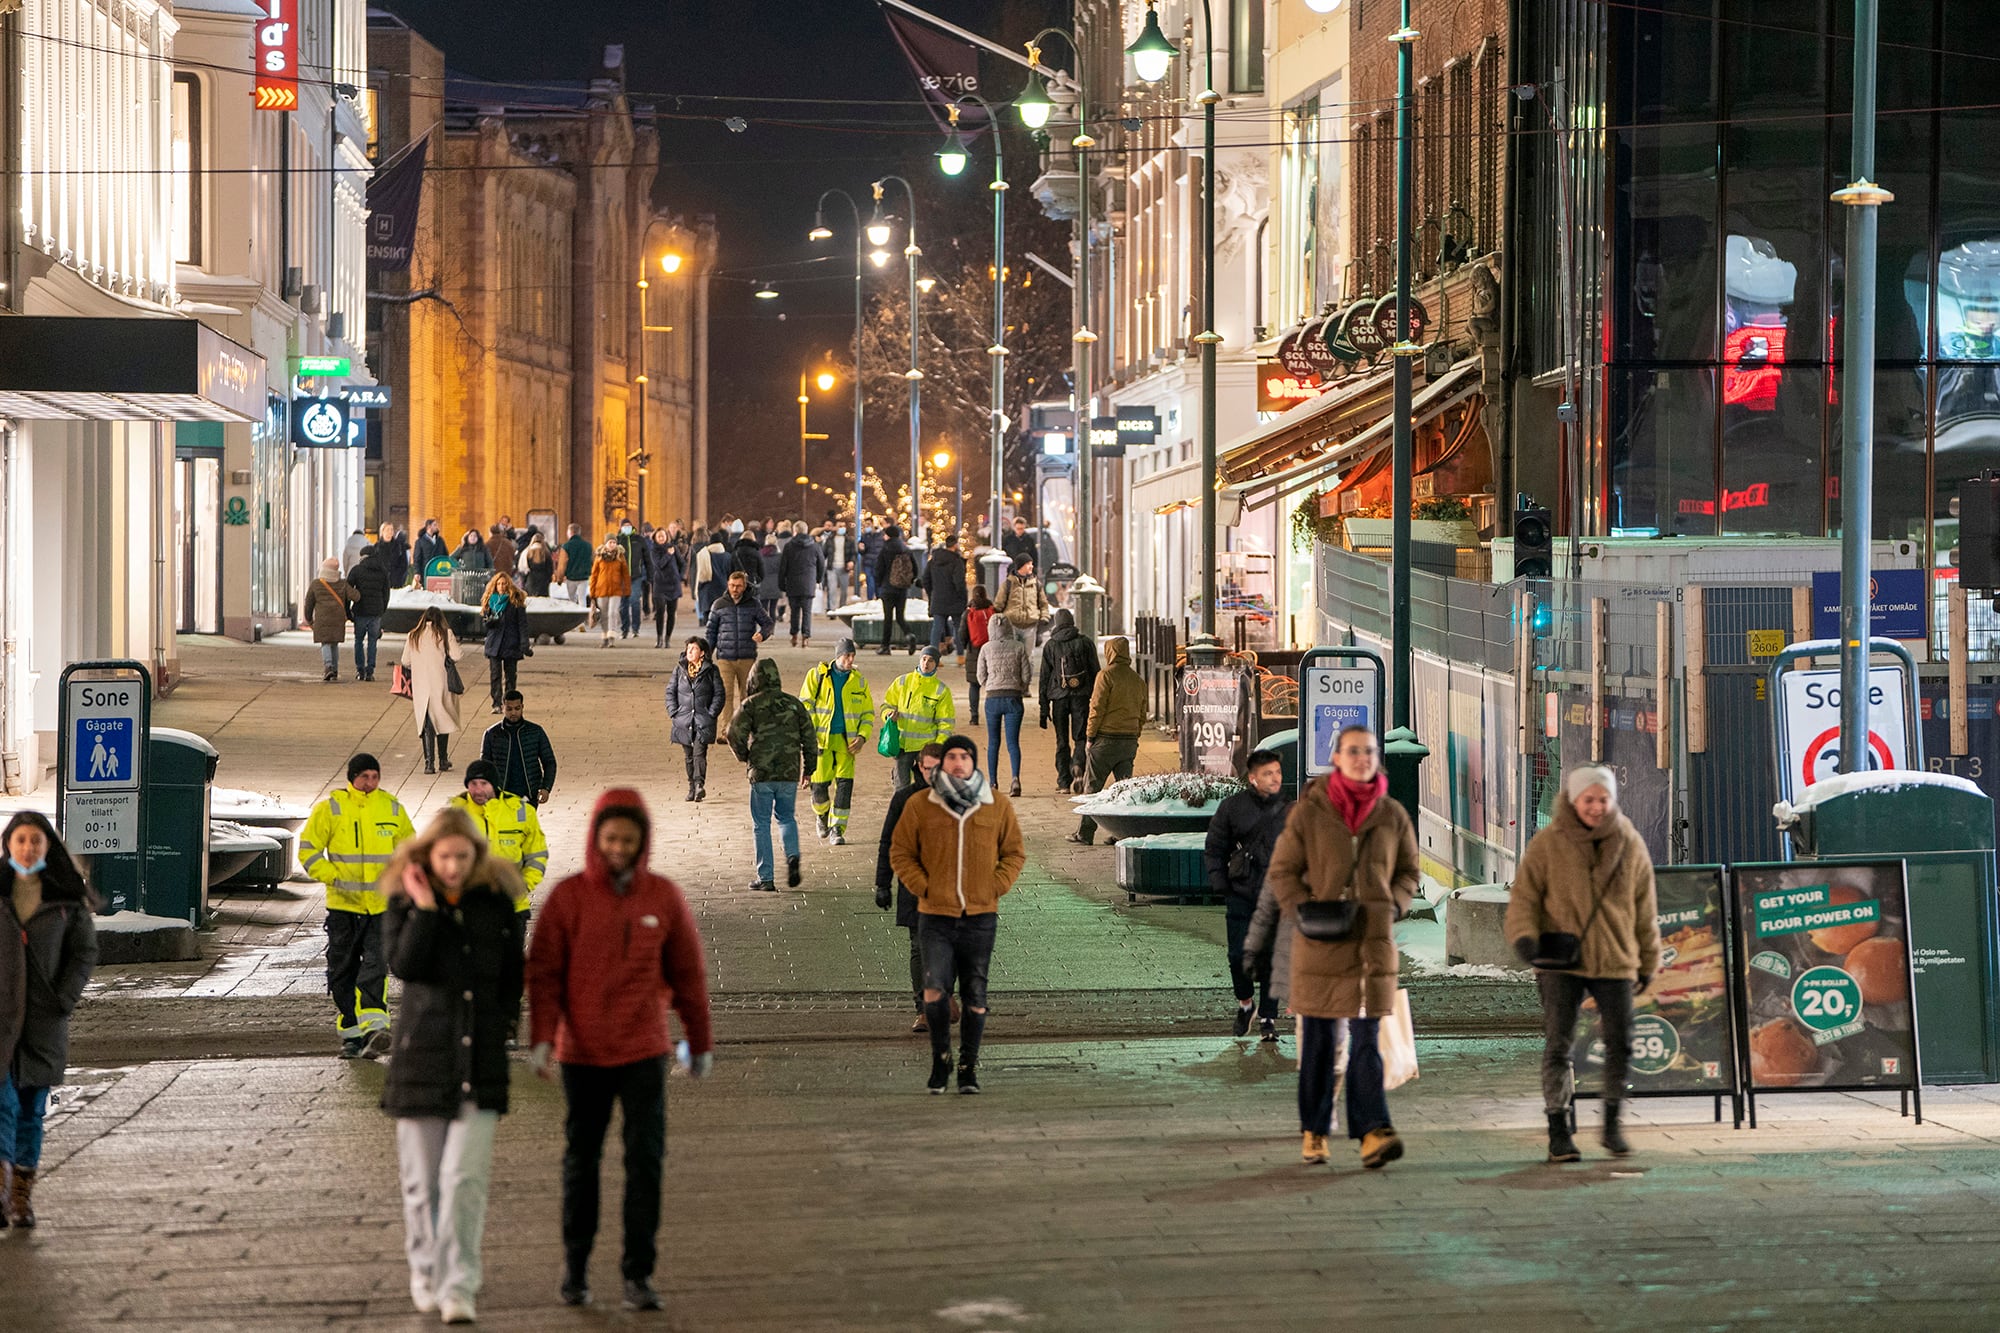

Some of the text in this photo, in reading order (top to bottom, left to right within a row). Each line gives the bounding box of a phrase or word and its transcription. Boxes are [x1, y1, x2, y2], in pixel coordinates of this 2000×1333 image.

[367, 245, 408, 259] ENSIKT
[1351, 326, 1375, 335] SCO
[340, 391, 388, 403] ZARA
[1117, 420, 1154, 431] KICKS
[1889, 601, 1918, 612] OMRÅDE
[1753, 642, 1778, 653] 2606
[1319, 674, 1364, 694] Sone
[81, 688, 129, 707] Sone
[1805, 682, 1884, 709] Soe
[1183, 704, 1239, 714] STUDENTTILBUD
[1323, 706, 1360, 720] Gågate
[85, 720, 124, 734] Gågate
[1929, 756, 1983, 778] RT 3
[75, 796, 129, 806] Varetransport
[91, 808, 113, 817] tillatt
[1759, 890, 1824, 909] GET YOUR
[1656, 910, 1700, 925] OUT ME
[1761, 906, 1874, 932] FLOUR POWER ON
[1821, 979, 1849, 987] BOLLER
